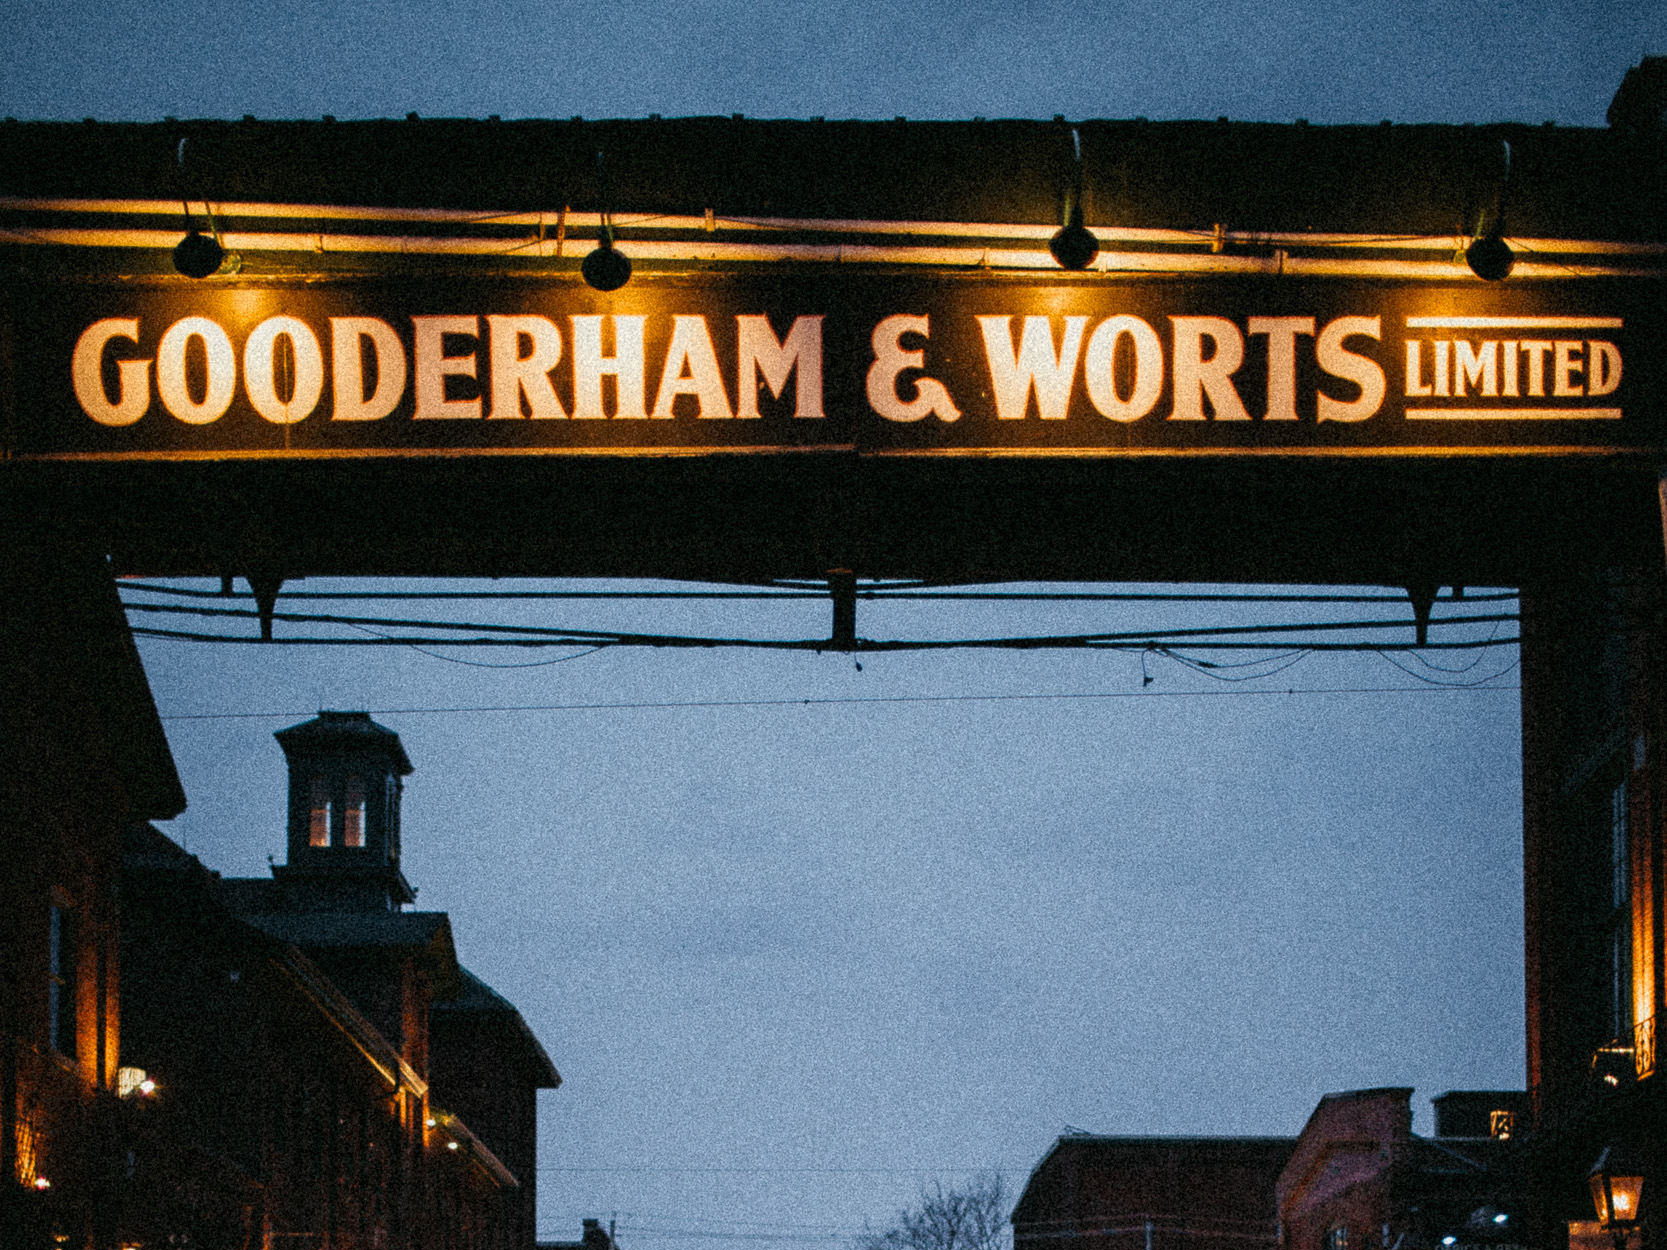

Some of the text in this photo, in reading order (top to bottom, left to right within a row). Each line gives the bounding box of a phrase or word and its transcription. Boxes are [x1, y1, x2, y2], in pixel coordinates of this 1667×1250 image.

[71, 313, 1624, 426] GOODERHAM & WORTS LIMITED
